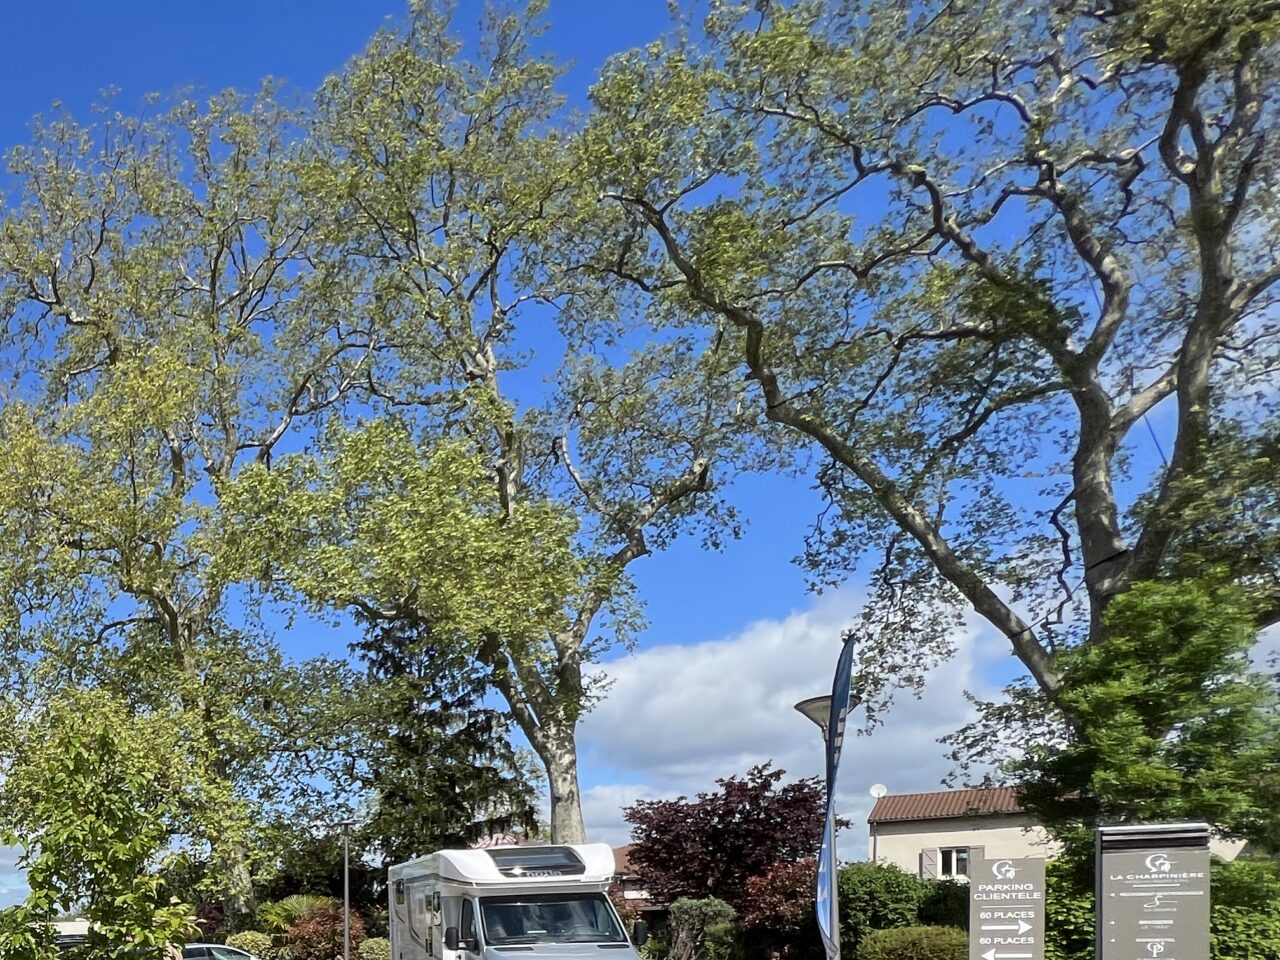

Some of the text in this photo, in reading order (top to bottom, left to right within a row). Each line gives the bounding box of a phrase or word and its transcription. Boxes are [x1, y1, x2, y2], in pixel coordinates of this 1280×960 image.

[978, 883, 1034, 891] PARKING
[974, 892, 1042, 900] CLIENTELE
[994, 911, 1035, 919] PLACES
